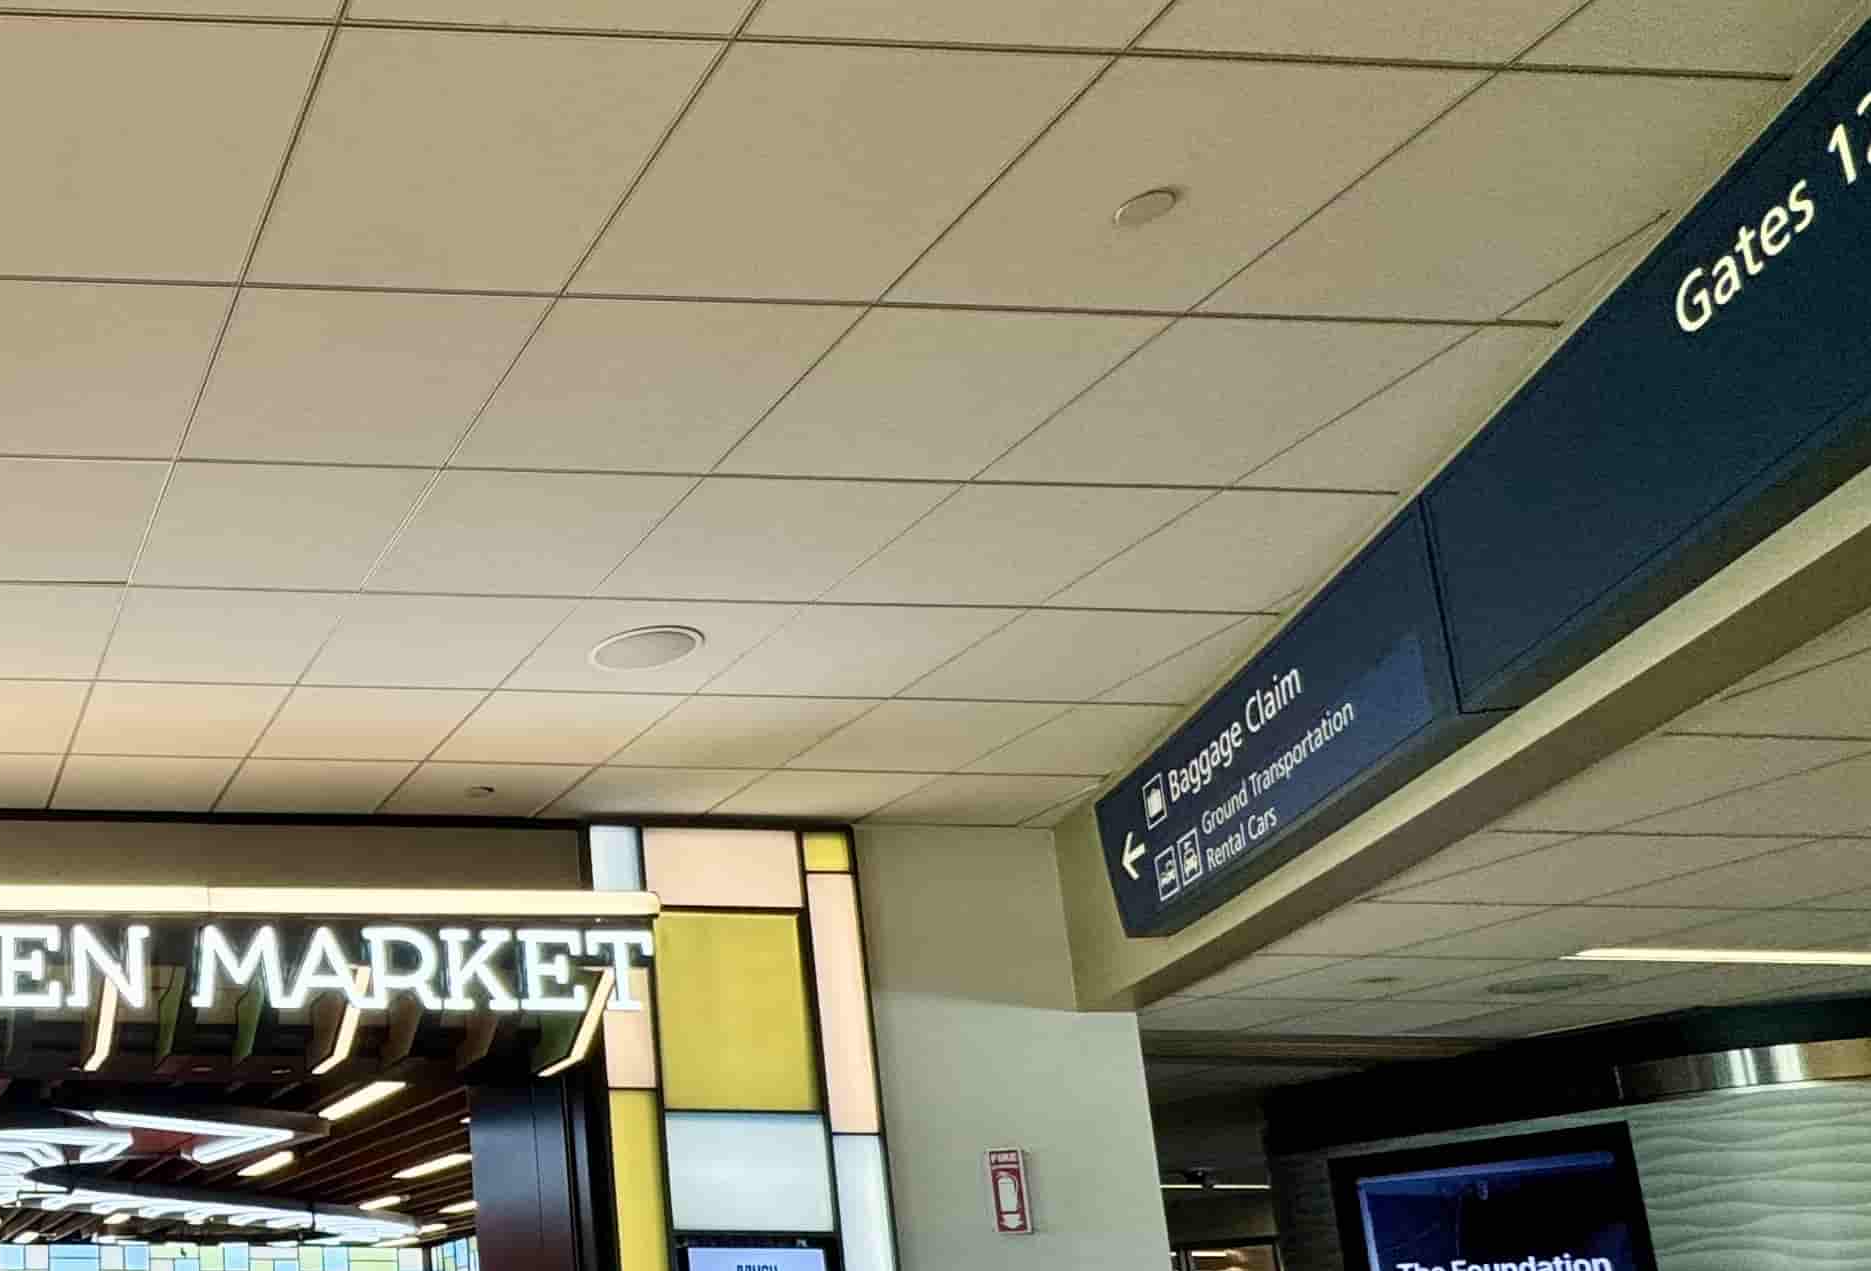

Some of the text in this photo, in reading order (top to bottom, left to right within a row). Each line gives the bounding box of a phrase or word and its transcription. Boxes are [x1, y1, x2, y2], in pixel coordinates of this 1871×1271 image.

[1675, 178, 1816, 333] Gates
[1167, 668, 1304, 802] Baggage Claim
[1201, 701, 1355, 835] Ground Transportation
[1206, 807, 1278, 872] Rental Cars
[190, 924, 654, 1012] MARKET
